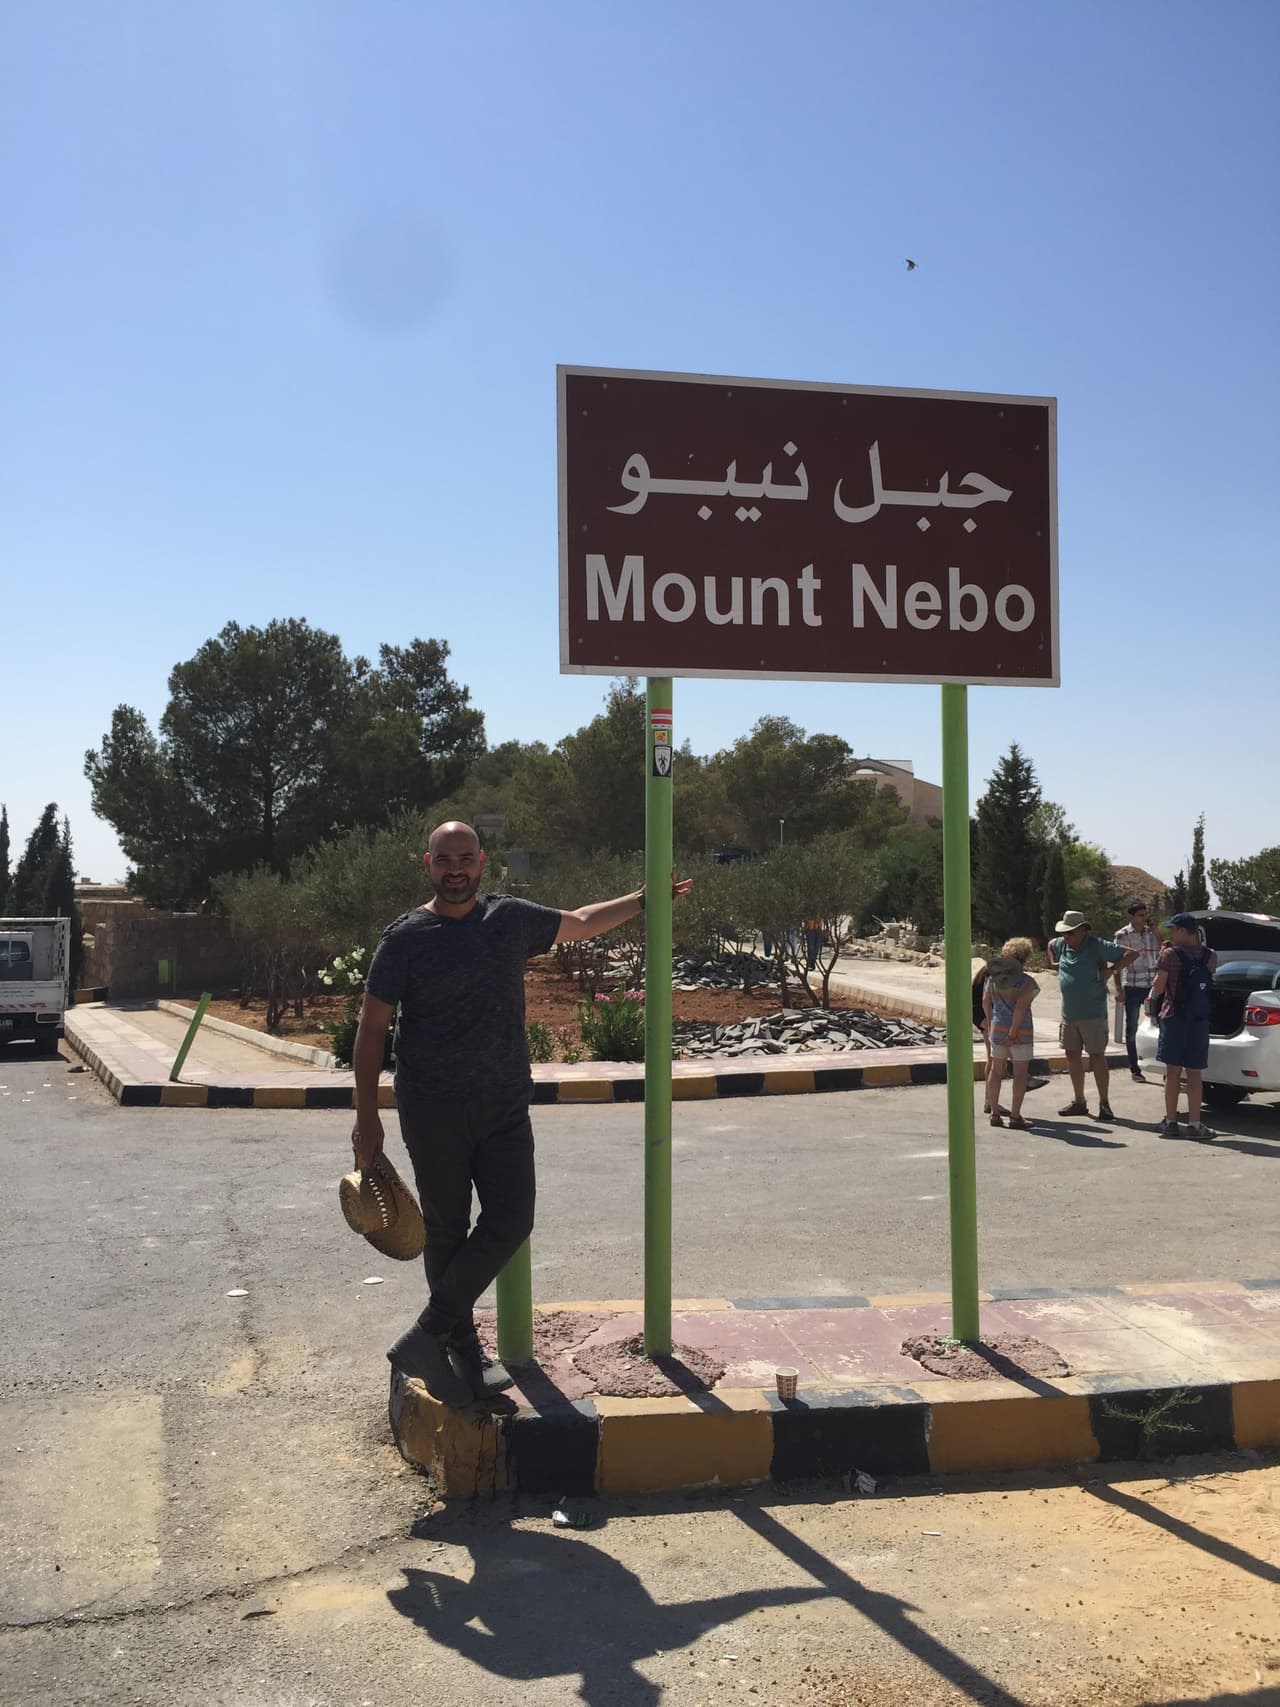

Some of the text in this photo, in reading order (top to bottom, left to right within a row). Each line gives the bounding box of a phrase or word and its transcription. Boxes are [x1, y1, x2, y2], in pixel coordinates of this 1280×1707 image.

[606, 440, 1013, 533] جبل نيبو
[585, 554, 1036, 632] Mount Nebo
